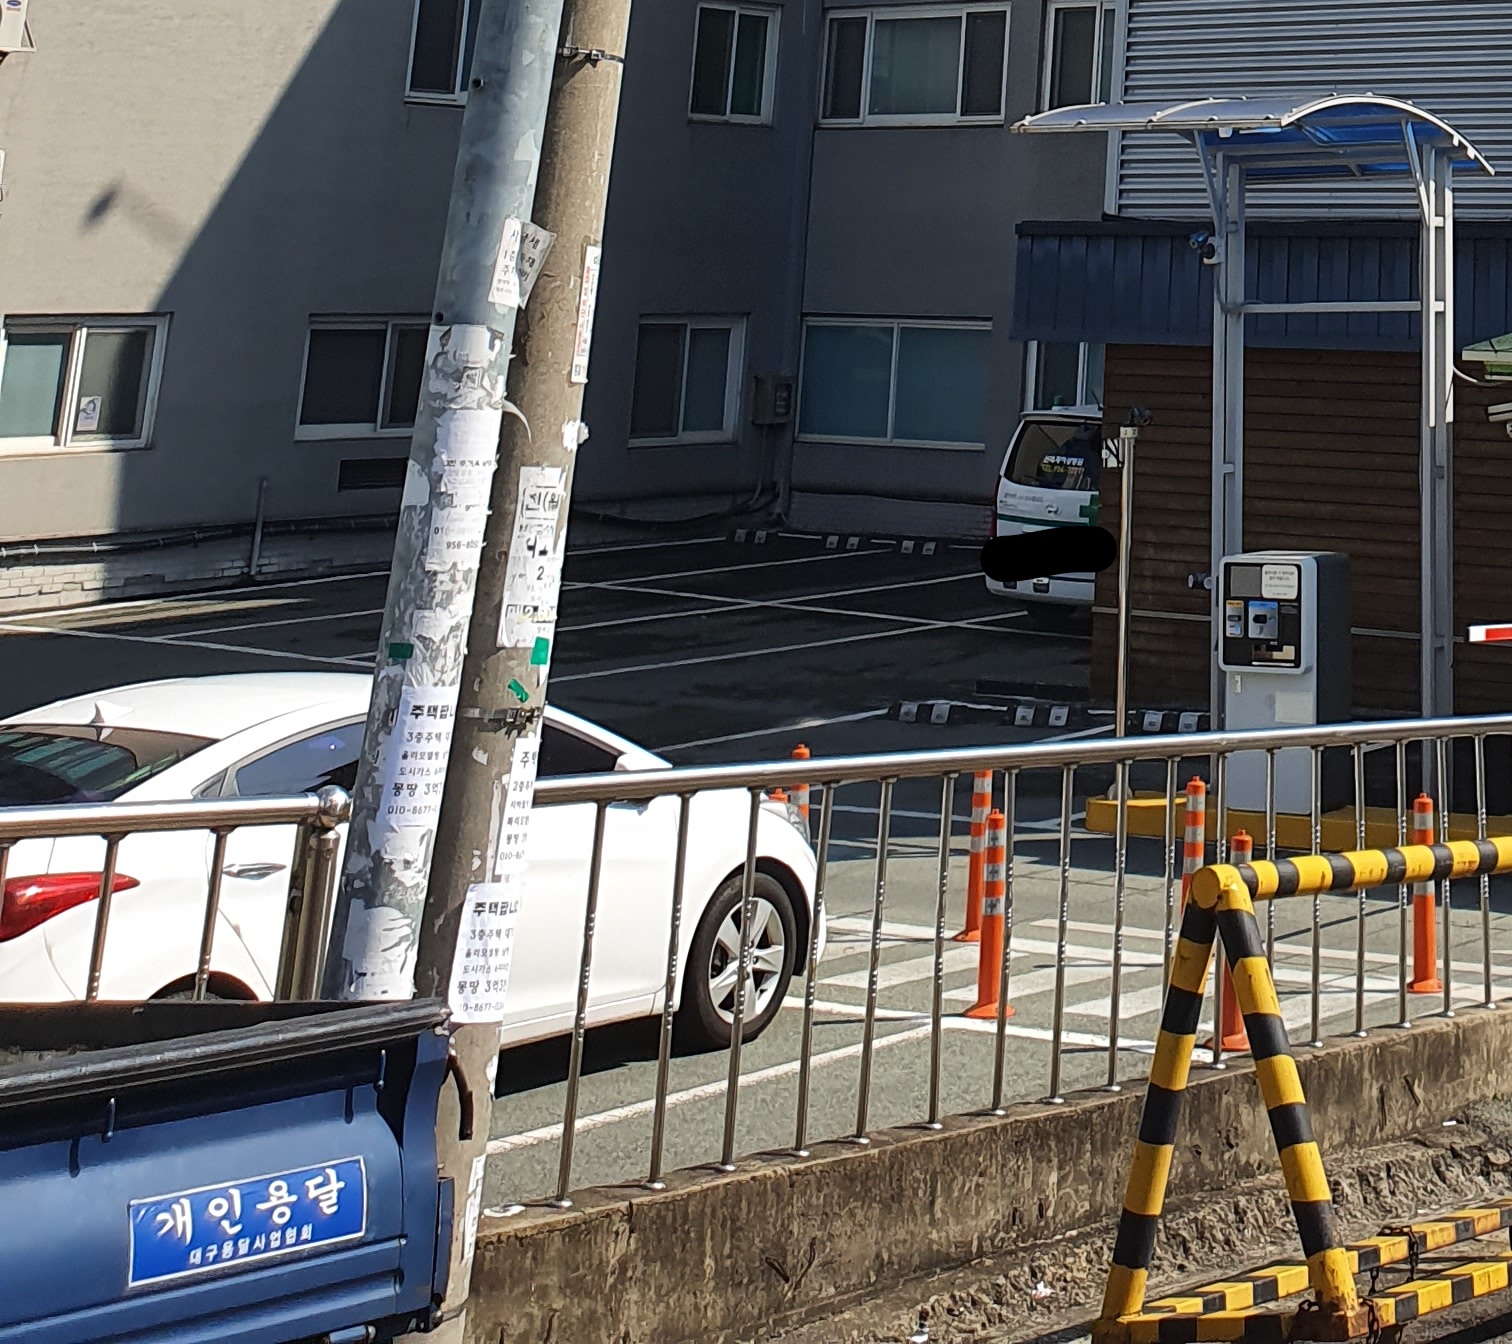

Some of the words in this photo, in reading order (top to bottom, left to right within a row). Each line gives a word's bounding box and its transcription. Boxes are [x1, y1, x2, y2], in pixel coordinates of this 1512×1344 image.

[387, 805, 438, 815] 010-8677-
[155, 1167, 346, 1247] 개인용달
[189, 1223, 314, 1266] 대구용달사업협회
